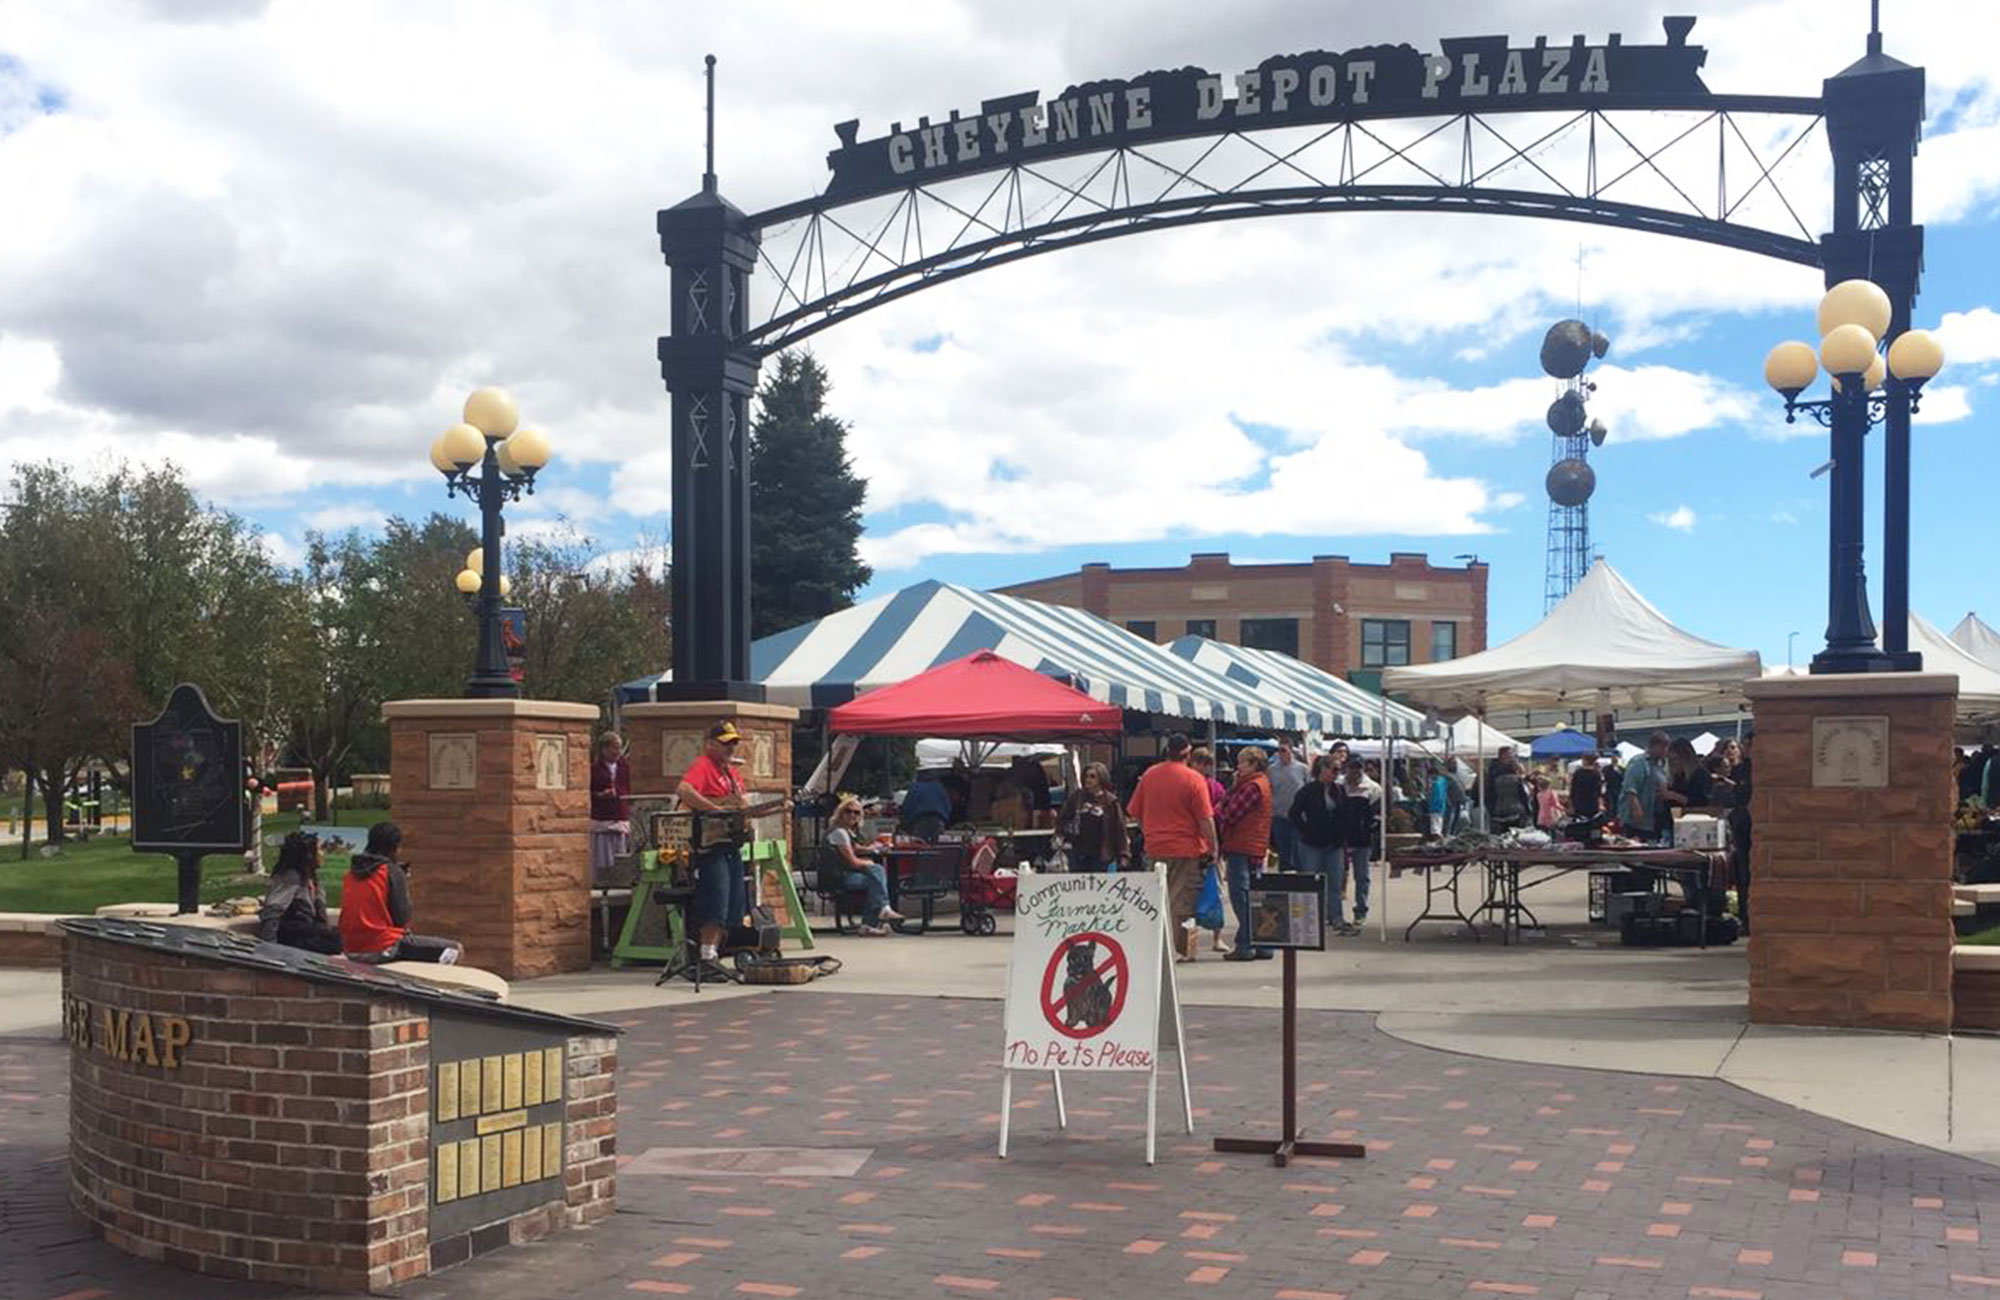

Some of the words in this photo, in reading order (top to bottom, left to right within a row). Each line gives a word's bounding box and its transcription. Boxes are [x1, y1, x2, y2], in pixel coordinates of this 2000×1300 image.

[888, 87, 1152, 174] CHEYENNE
[1197, 61, 1375, 120] DEPOT
[1421, 48, 1609, 98] PLAZA
[1016, 875, 1107, 916] Community
[1108, 877, 1159, 921] Action
[103, 1007, 191, 1068] MAP
[1043, 1041, 1094, 1067] Pets
[1098, 1041, 1153, 1067] Please
